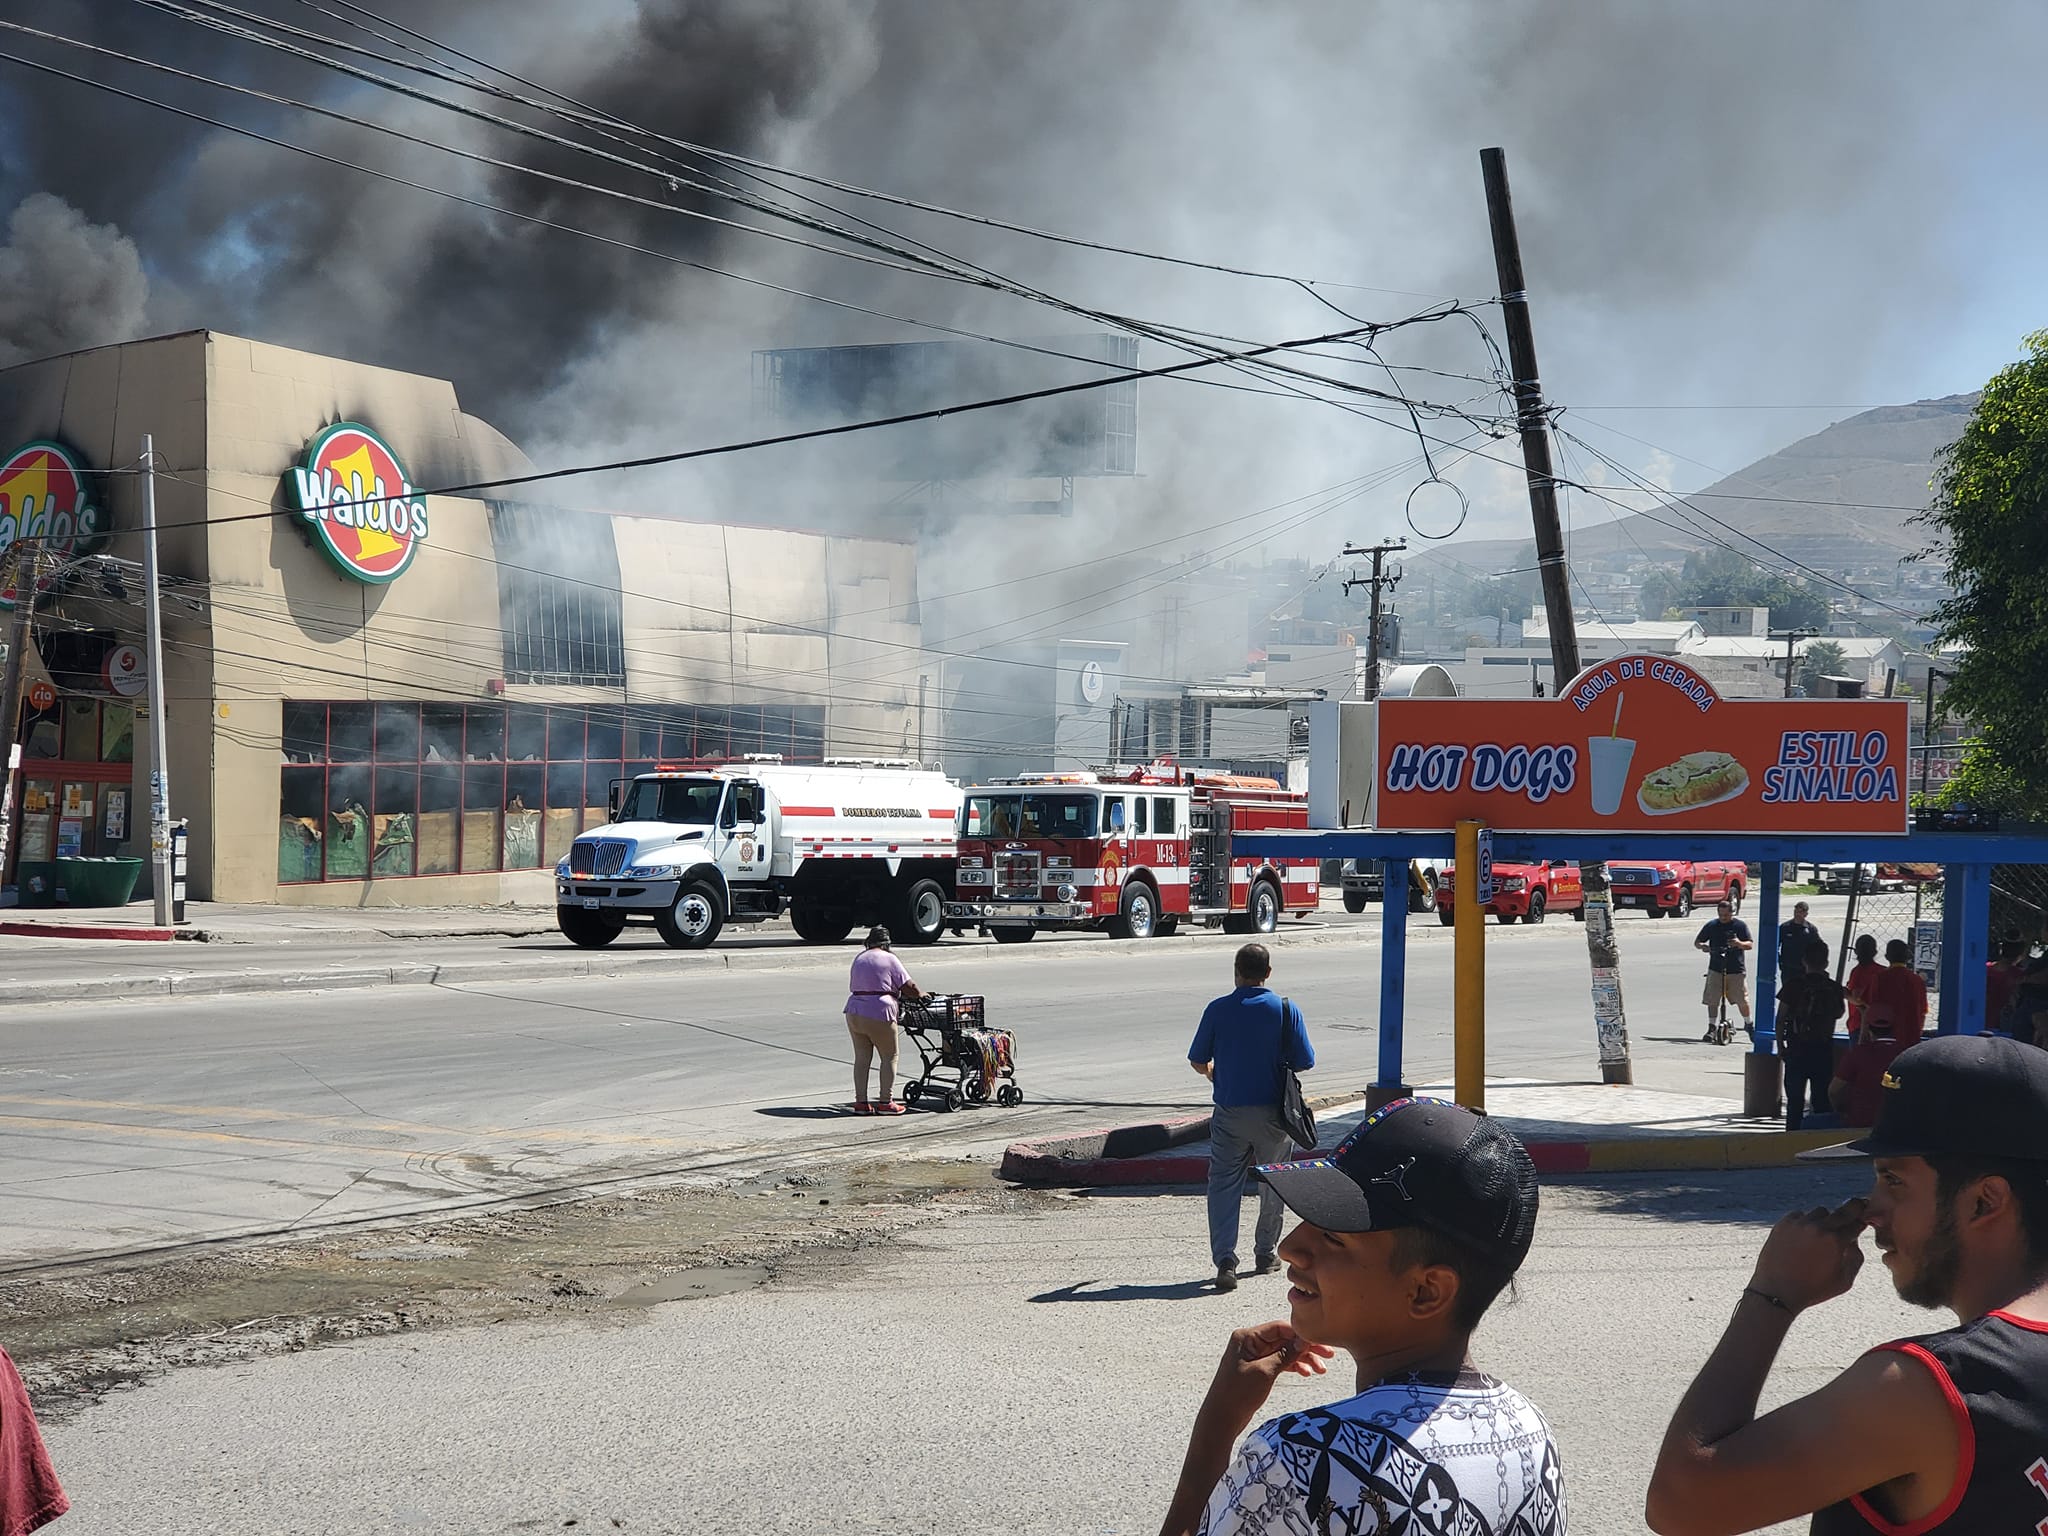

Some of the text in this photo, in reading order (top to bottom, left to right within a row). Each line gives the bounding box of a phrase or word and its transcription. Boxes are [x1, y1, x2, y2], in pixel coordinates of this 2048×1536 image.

[0, 491, 96, 550] aldo's
[295, 467, 427, 537] Waldo's
[34, 687, 52, 700] ria
[1572, 660, 1714, 712] AGUA DE CEBADA
[1779, 731, 1887, 767] ESTILO
[1387, 745, 1576, 802] HOT DOGS
[1762, 766, 1898, 802] SINALOA
[842, 807, 887, 817] BOMBEROS
[1156, 843, 1174, 863] M-13
[1338, 1420, 1378, 1466] 1854
[1386, 1444, 1422, 1498] 1854
